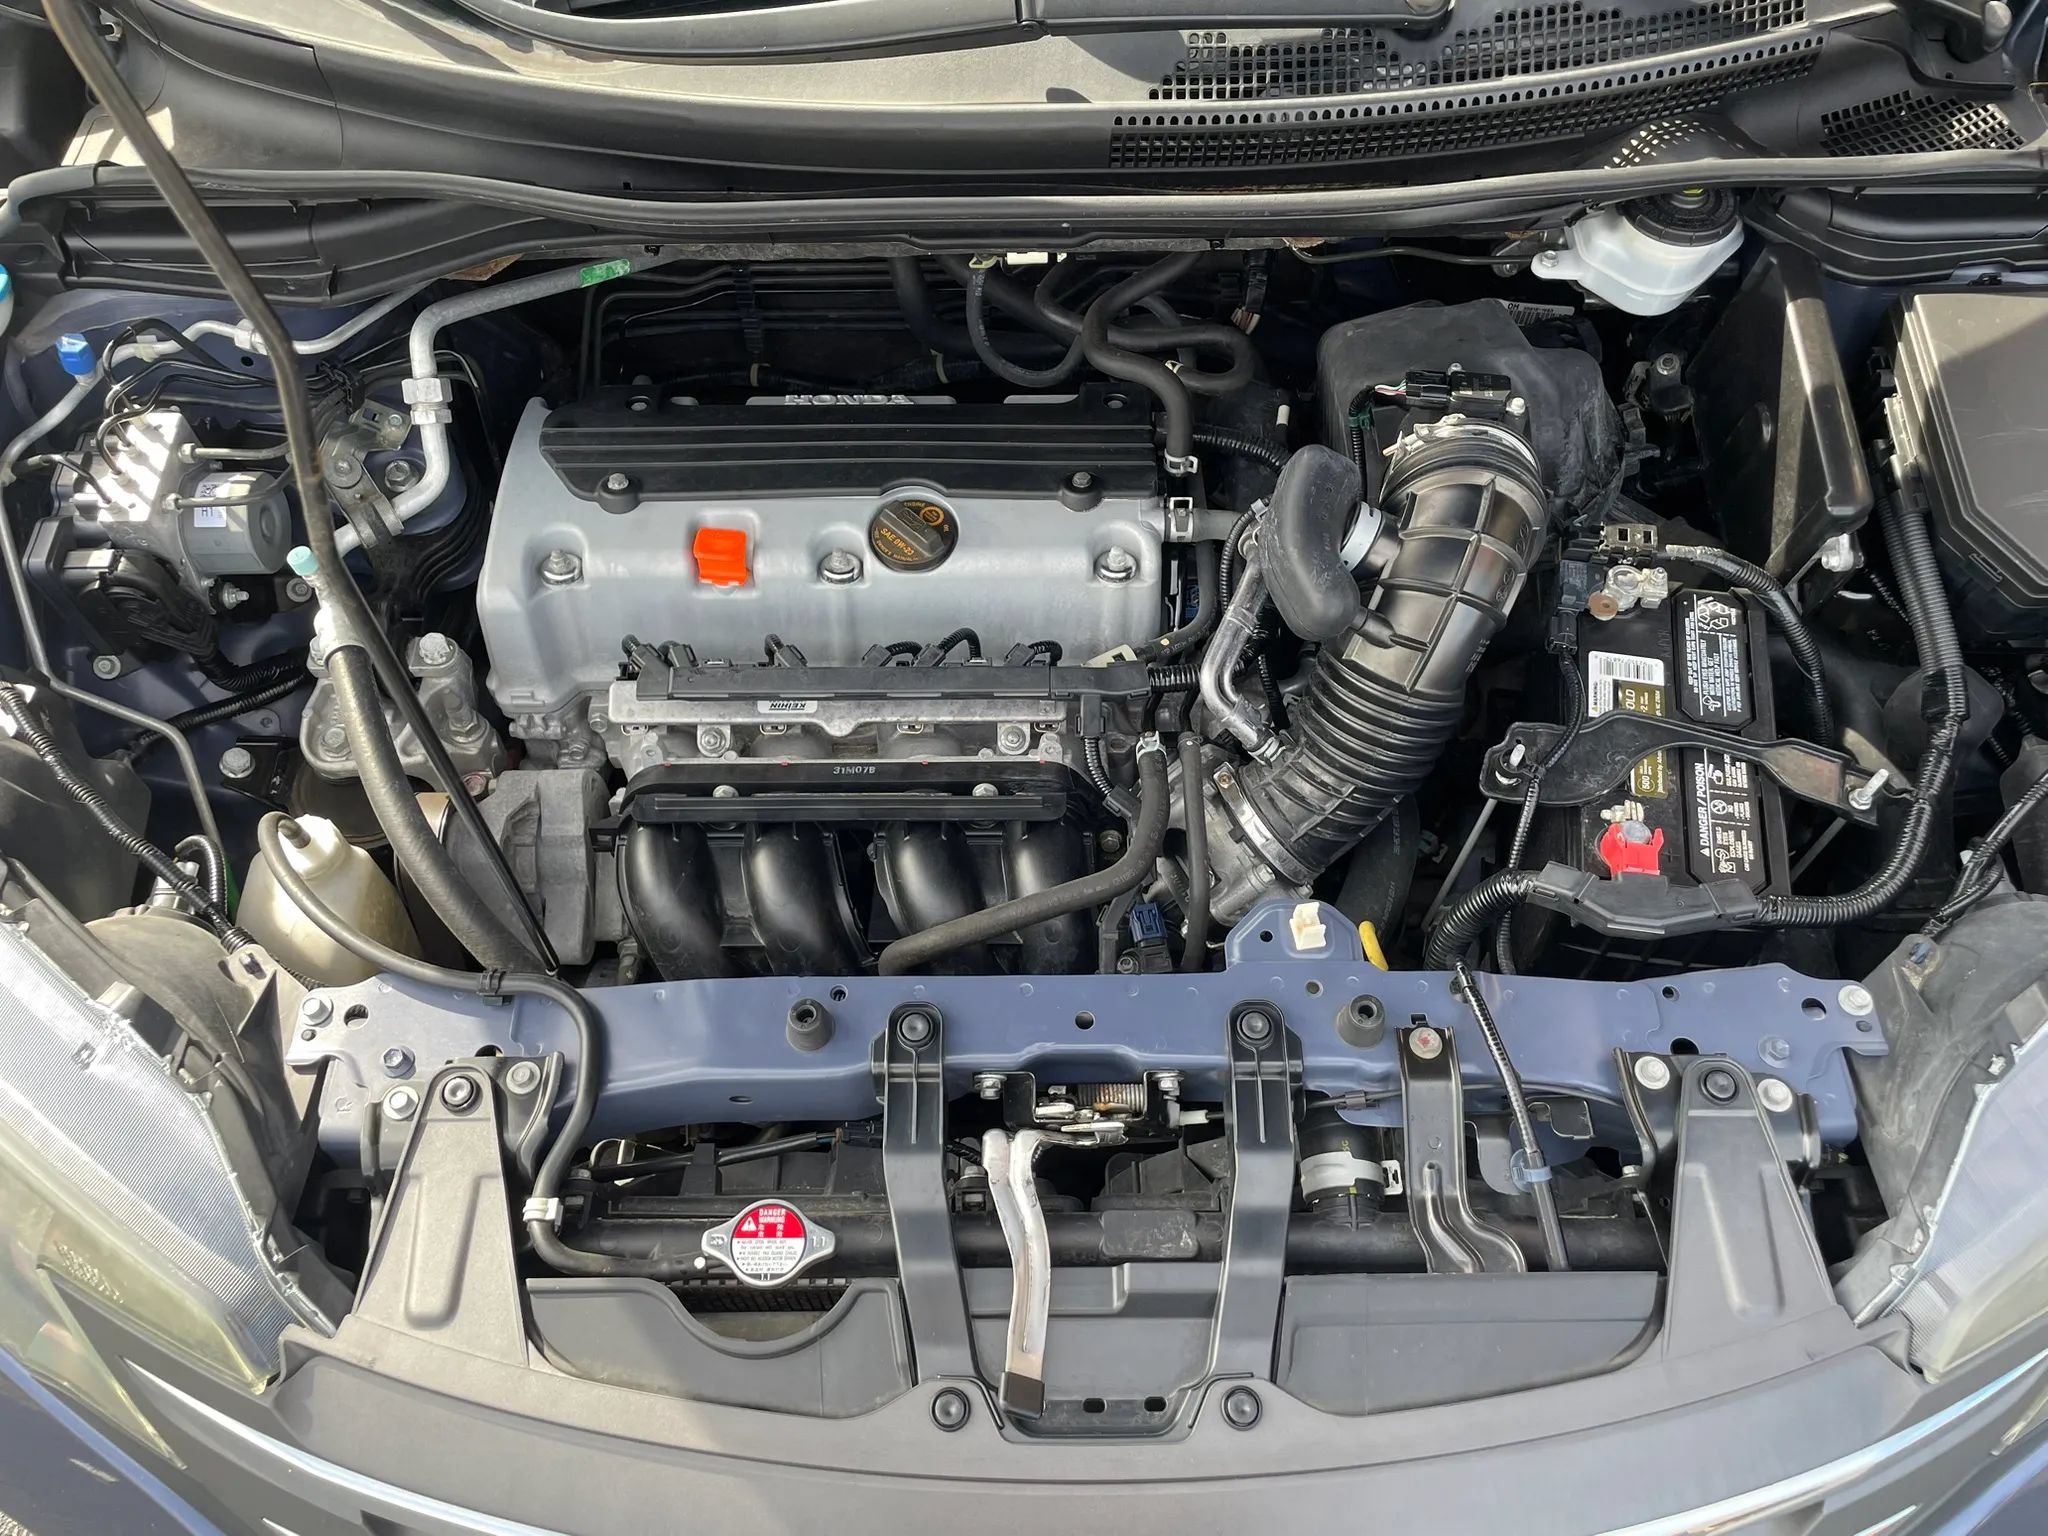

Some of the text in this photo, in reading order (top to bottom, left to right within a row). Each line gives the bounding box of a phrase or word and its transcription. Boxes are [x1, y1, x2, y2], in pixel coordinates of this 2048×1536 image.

[784, 394, 914, 405] HONDA
[880, 528, 914, 555] SAE 0W-20
[1625, 689, 1635, 710] OLD
[768, 702, 807, 711] KEIHIN
[833, 766, 876, 774] 31M07B
[1694, 763, 1709, 846] DANGER / POISON
[759, 1208, 786, 1216] DANGER
